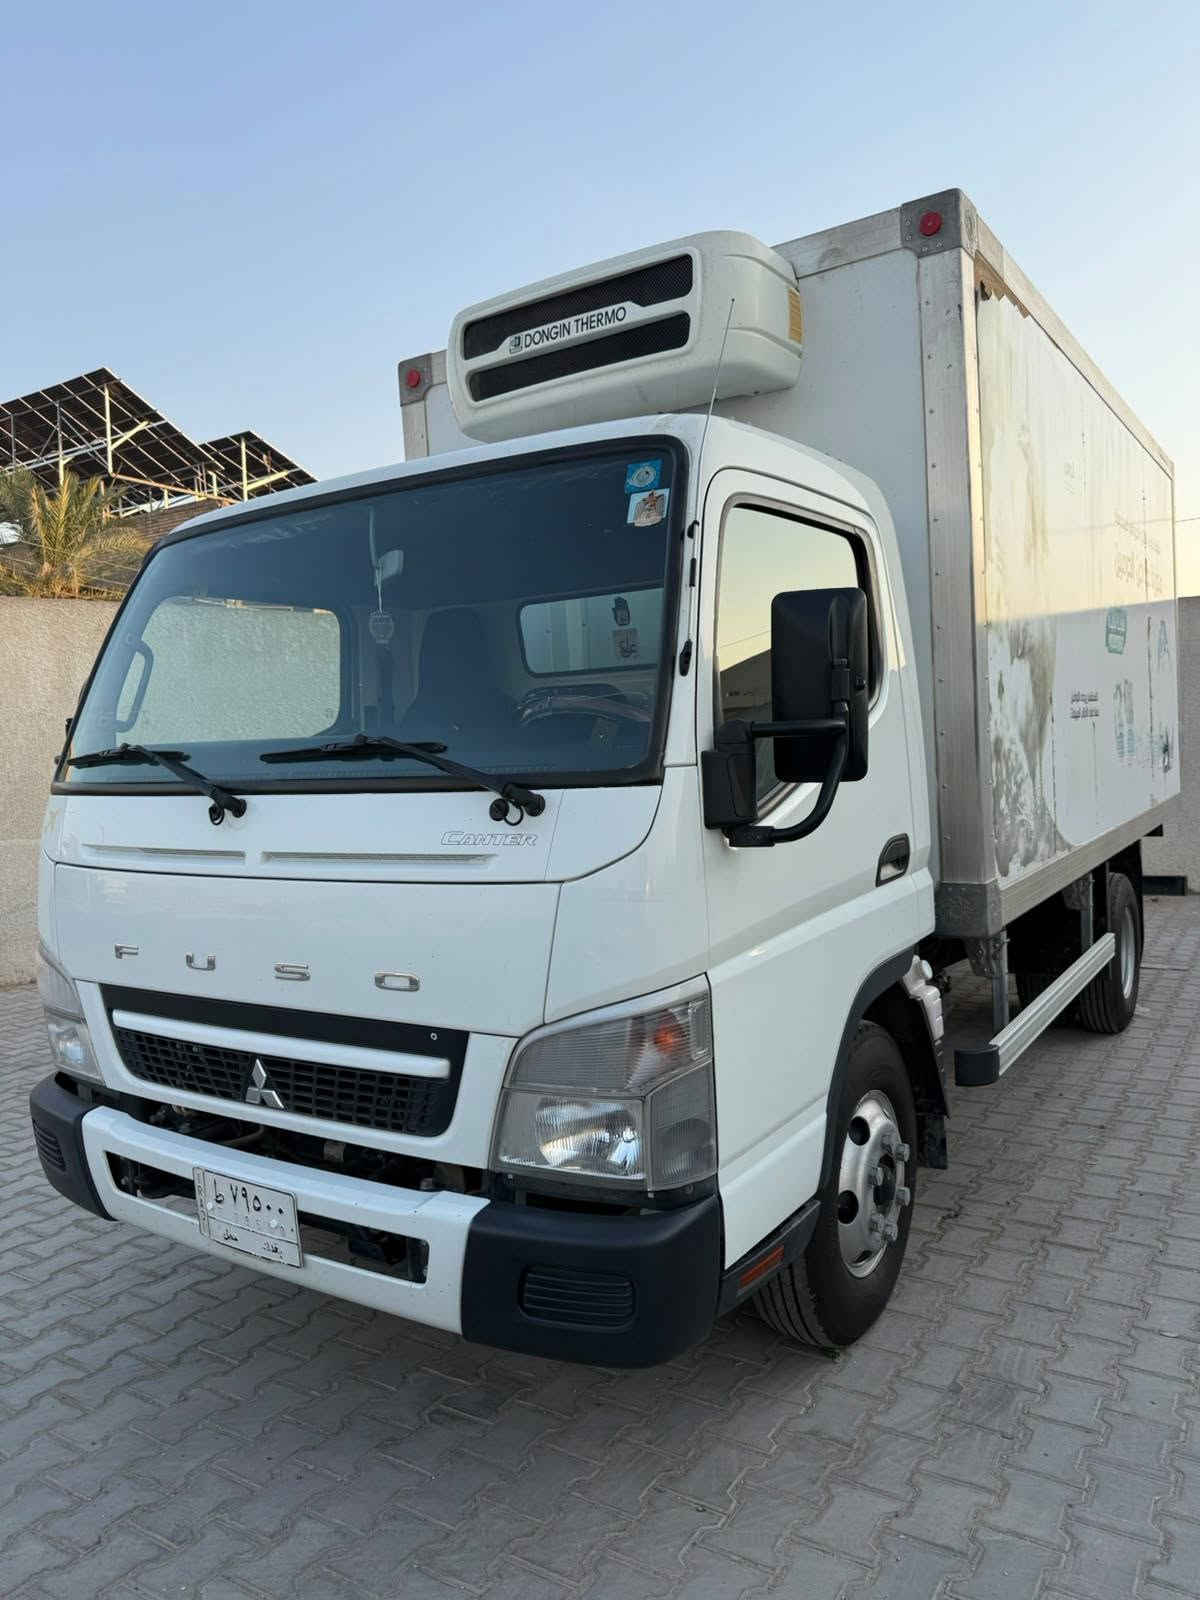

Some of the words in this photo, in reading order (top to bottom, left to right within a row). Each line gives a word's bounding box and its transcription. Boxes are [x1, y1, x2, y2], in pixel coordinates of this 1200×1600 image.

[523, 321, 571, 349] DONGIN
[573, 306, 627, 334] THERMO
[440, 830, 538, 847] CANTER
[114, 943, 420, 993] FUSO
